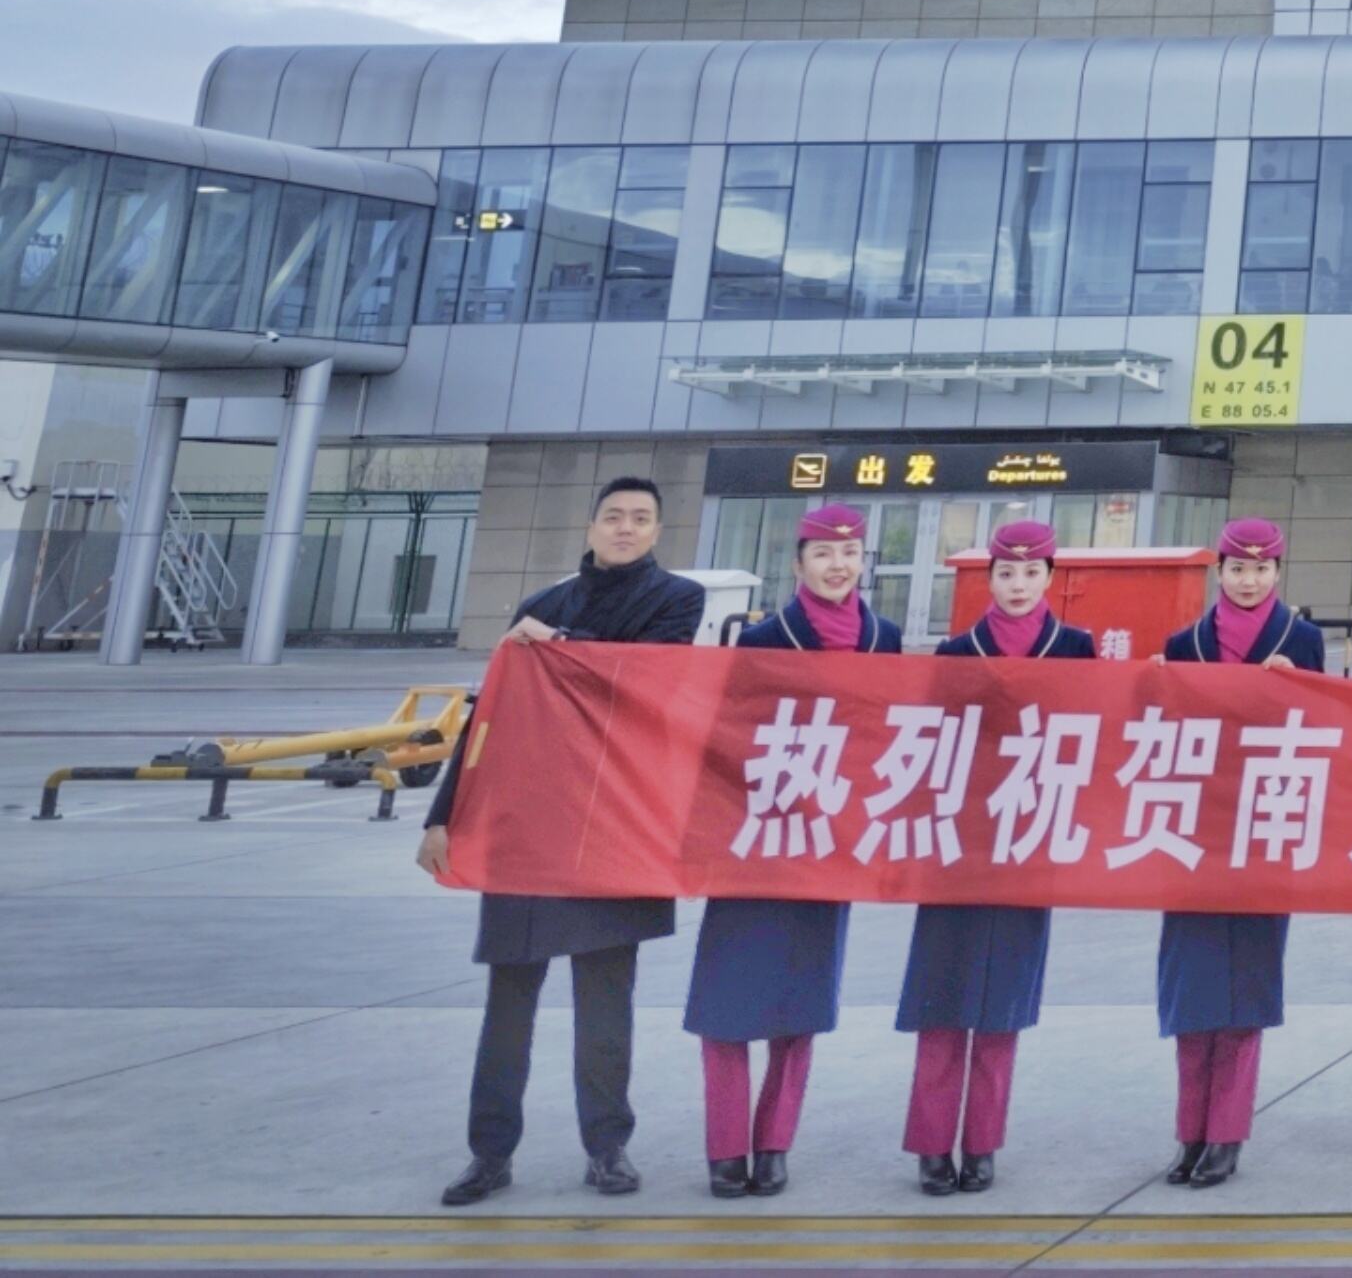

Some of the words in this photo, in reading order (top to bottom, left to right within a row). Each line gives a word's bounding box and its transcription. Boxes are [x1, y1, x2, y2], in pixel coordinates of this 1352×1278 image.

[1211, 321, 1290, 370] 04
[1203, 381, 1216, 394] N
[1224, 381, 1246, 394] 47
[1254, 381, 1290, 394] 45.1
[1200, 405, 1213, 418] E
[1222, 405, 1243, 418] 88
[1252, 405, 1288, 418] 05.4
[856, 454, 936, 485] 出发
[987, 470, 1067, 484] Departures
